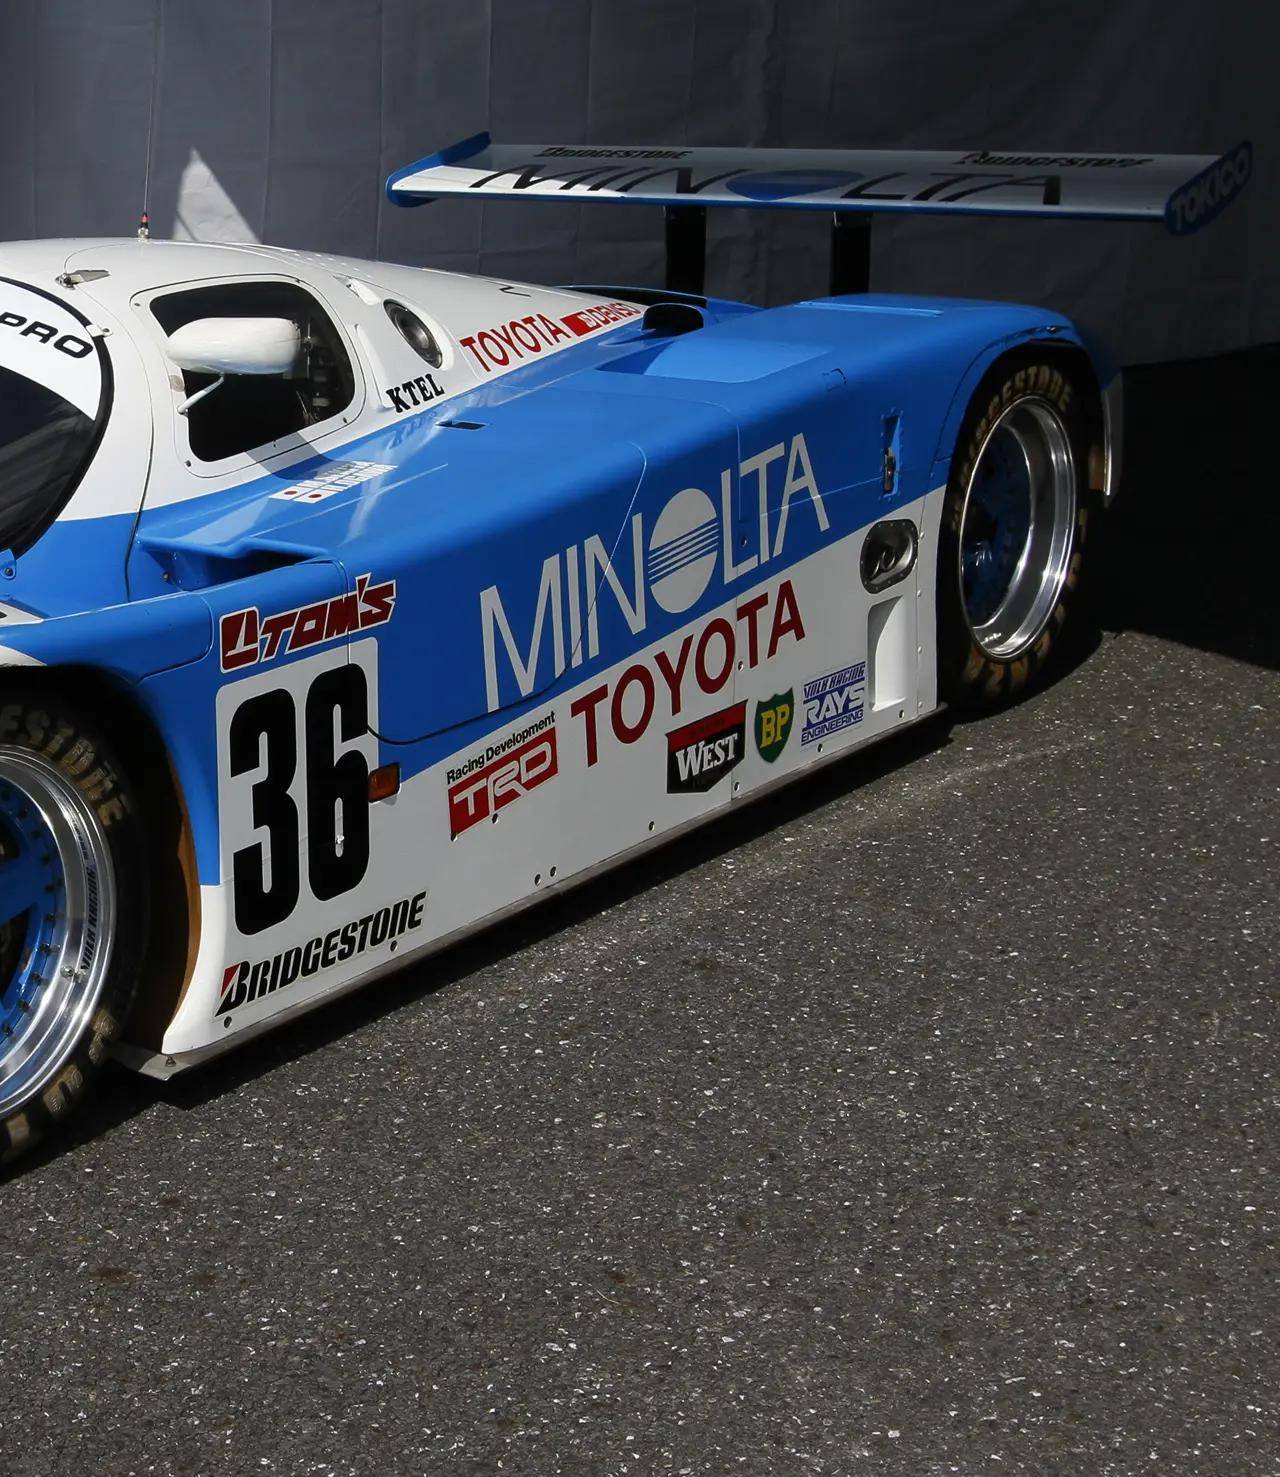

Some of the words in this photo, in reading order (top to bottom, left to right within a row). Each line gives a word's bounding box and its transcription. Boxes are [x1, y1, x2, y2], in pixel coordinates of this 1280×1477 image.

[469, 164, 1061, 205] MINOLTA
[459, 313, 571, 372] TOYOTA
[385, 373, 445, 413] KTEL
[480, 432, 830, 712] MINOLTA
[260, 573, 396, 662] TOM'S
[571, 580, 806, 767] TOYOTA
[829, 664, 866, 689] RACING
[760, 704, 791, 748] BP
[801, 709, 864, 742] ENGINEERING
[803, 682, 865, 727] RAYS
[446, 753, 485, 785] Racing
[486, 710, 556, 761] Development
[675, 732, 738, 782] WEST
[229, 663, 370, 936] 36
[453, 742, 552, 816] TRD
[215, 890, 427, 1017] BRIDGESTONE
